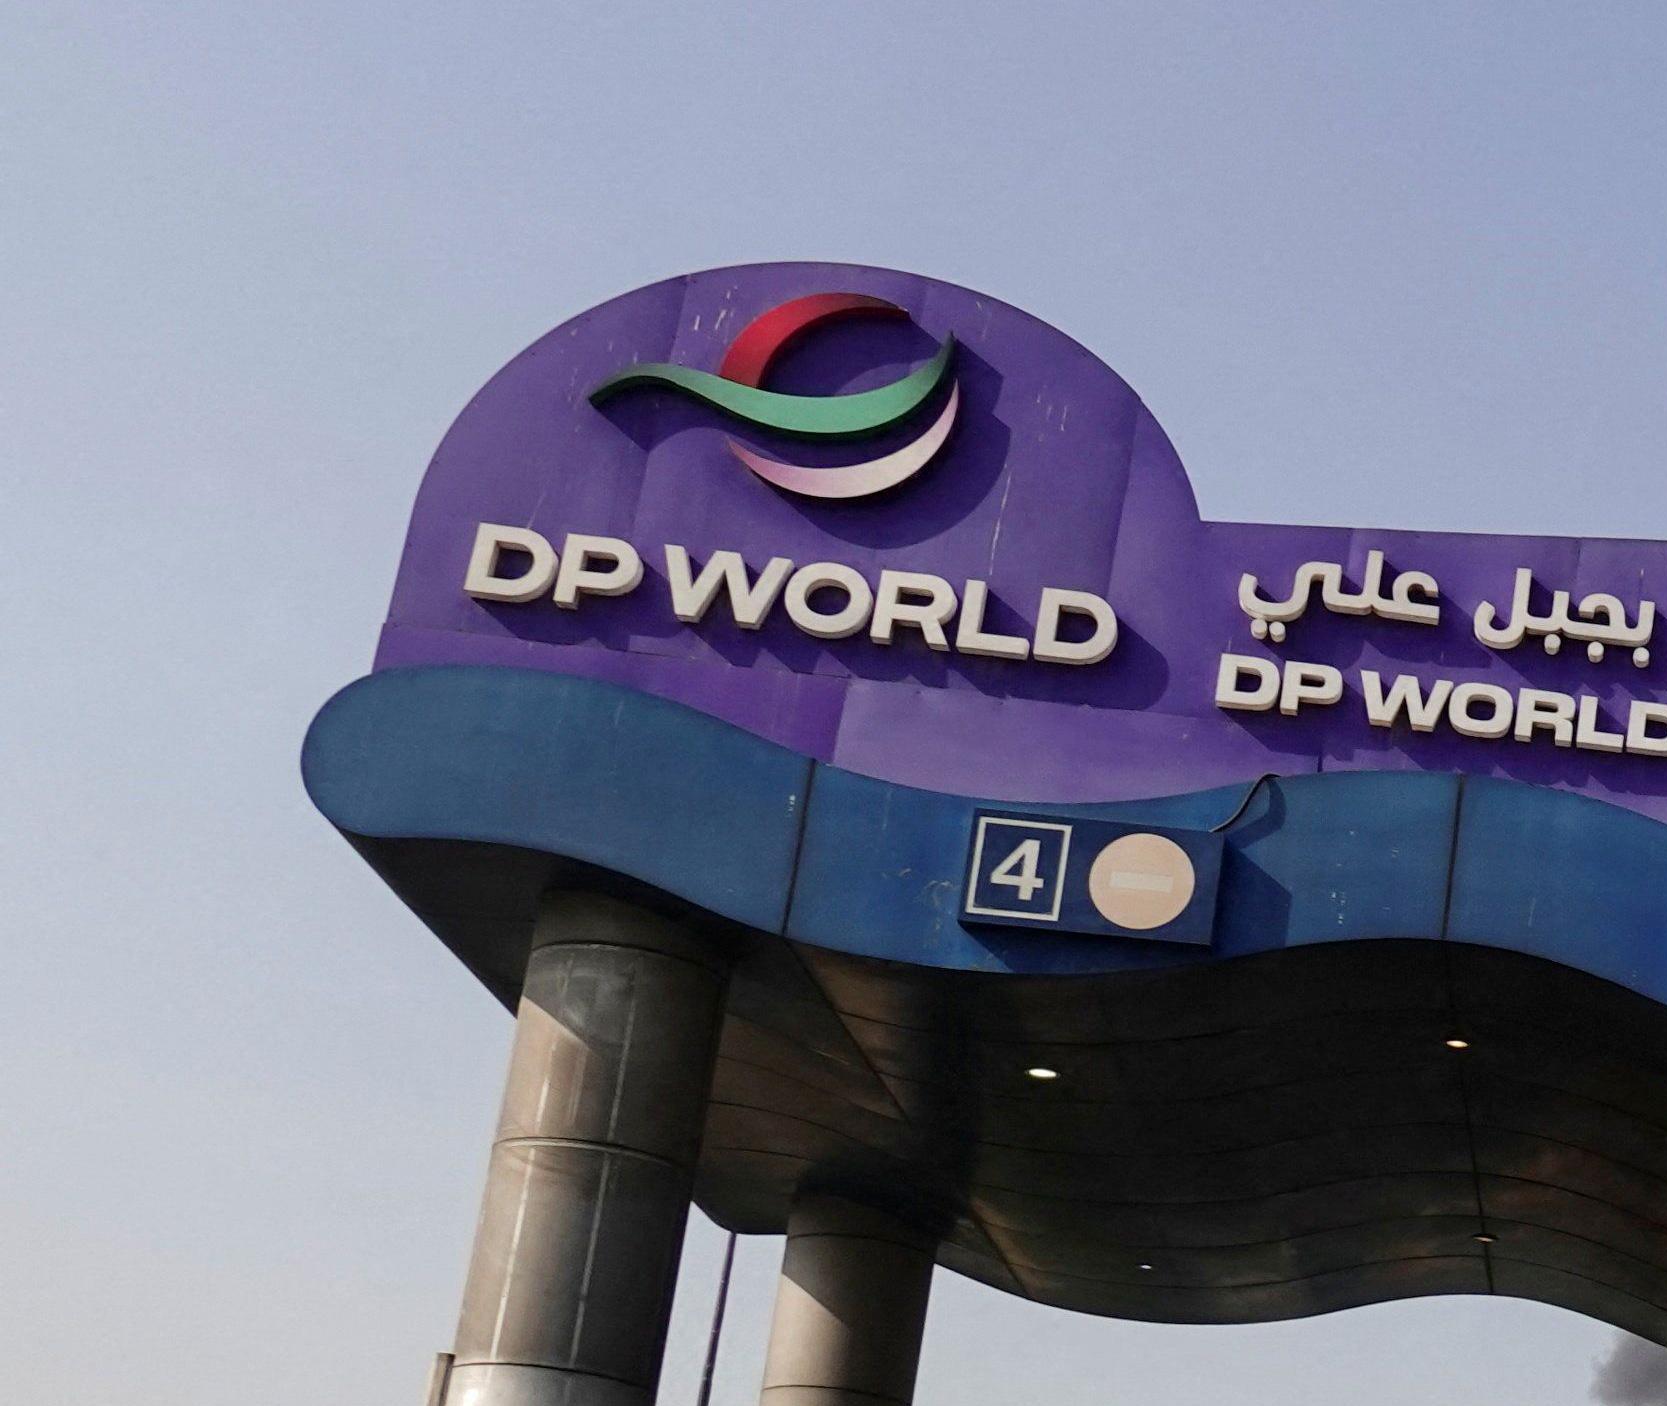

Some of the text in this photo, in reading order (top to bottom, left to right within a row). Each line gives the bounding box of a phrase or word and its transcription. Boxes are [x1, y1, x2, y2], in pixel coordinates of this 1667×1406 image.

[463, 522, 1119, 666] DP WORLD
[1238, 549, 1440, 644] علي
[1472, 567, 1656, 669] بجبل
[1214, 652, 1344, 717] DP
[990, 839, 1044, 901] 4
